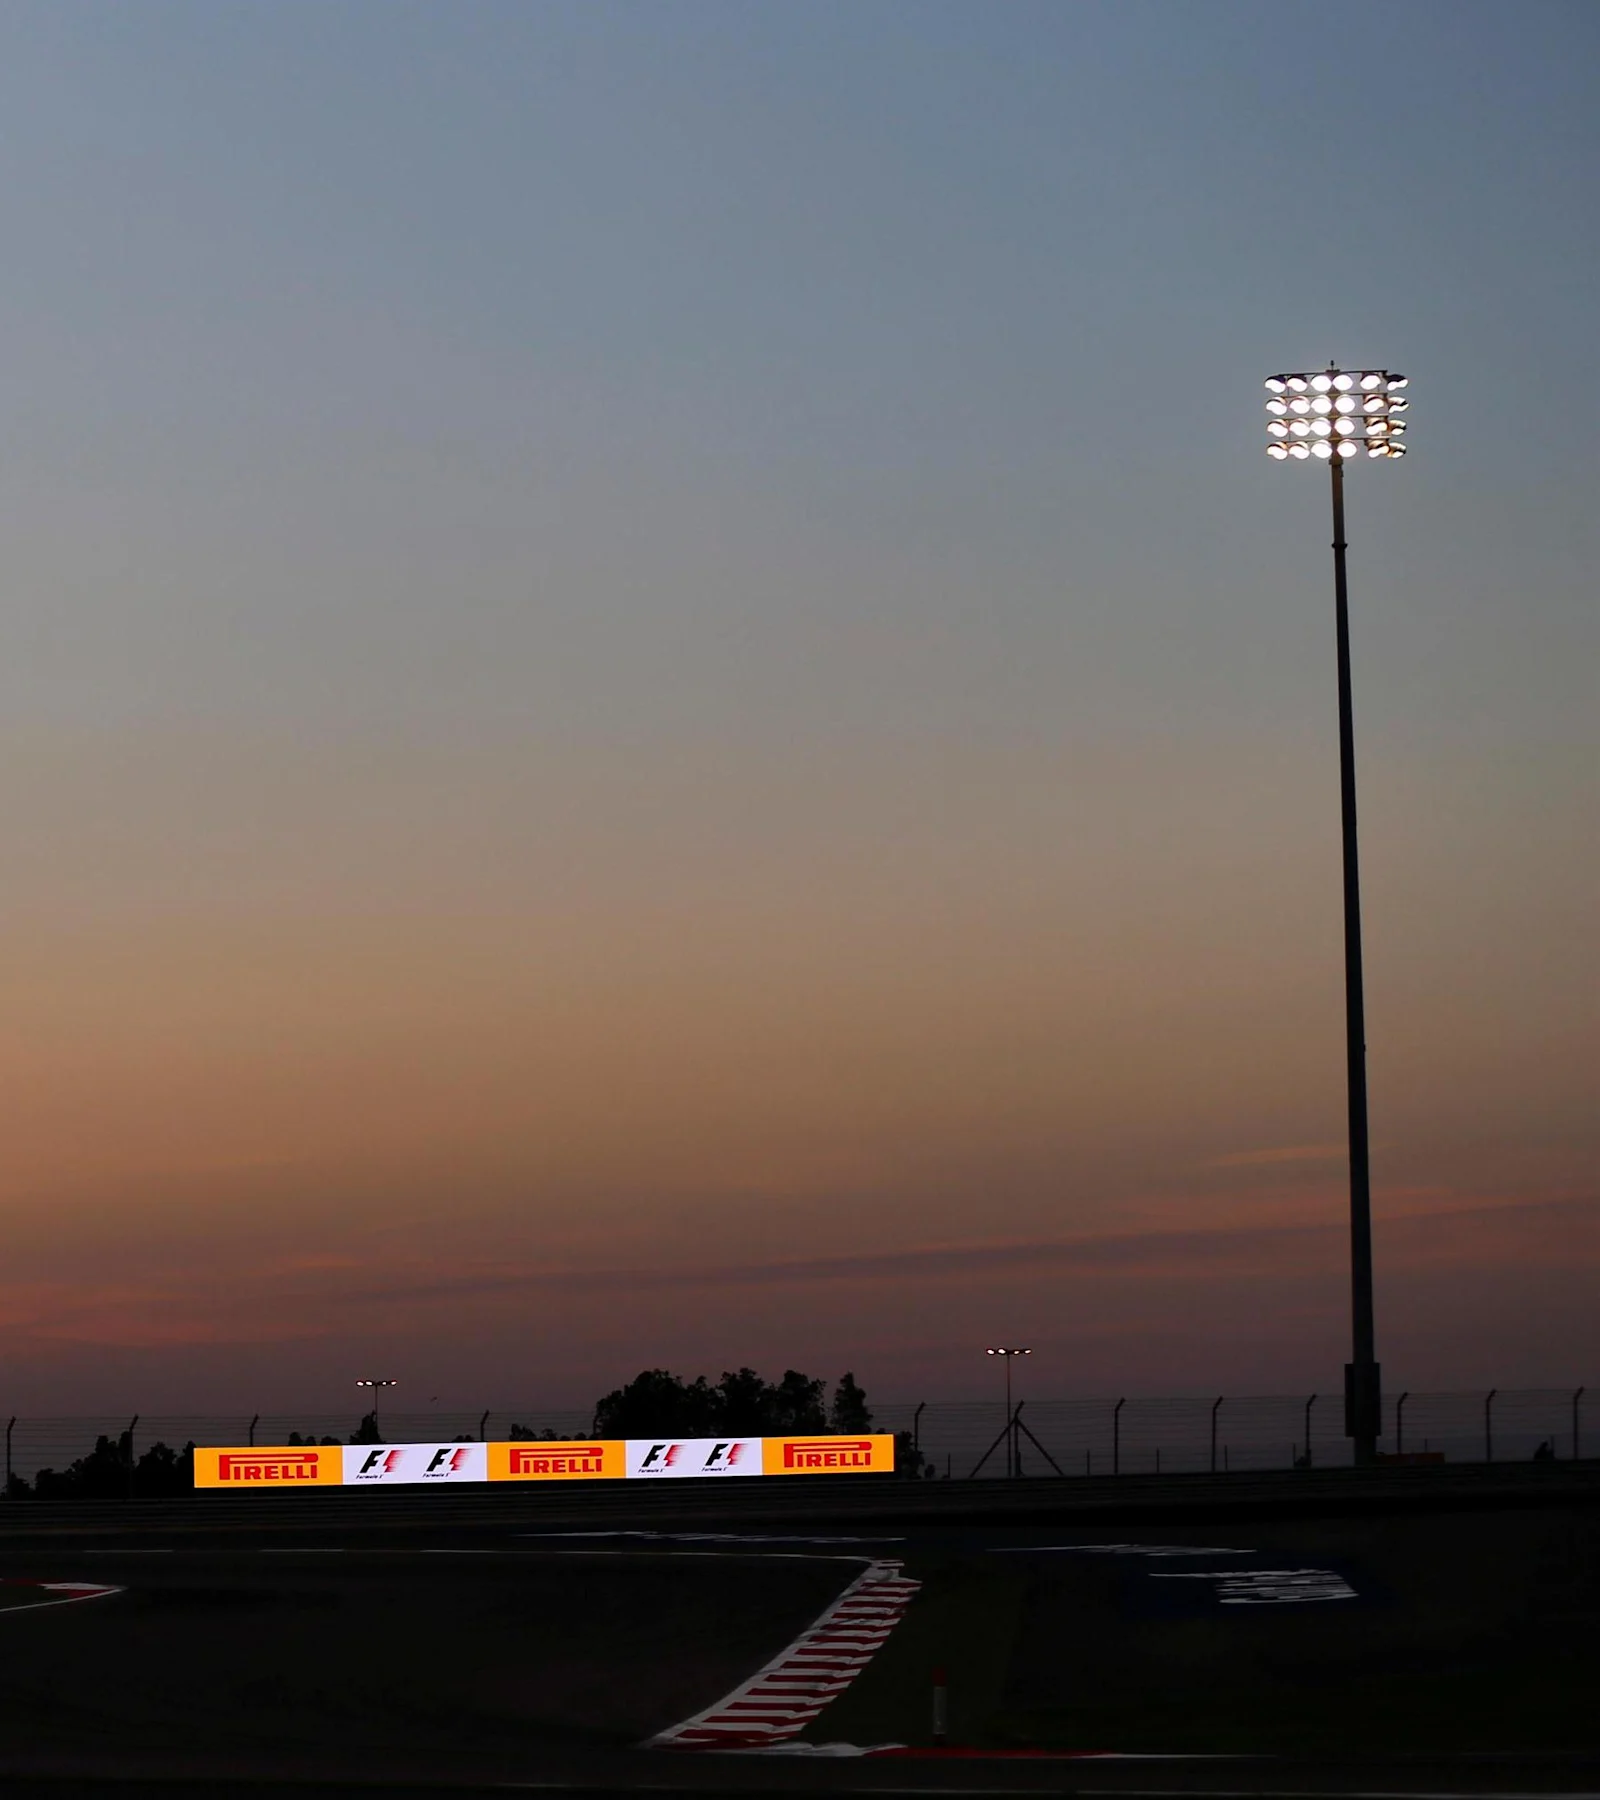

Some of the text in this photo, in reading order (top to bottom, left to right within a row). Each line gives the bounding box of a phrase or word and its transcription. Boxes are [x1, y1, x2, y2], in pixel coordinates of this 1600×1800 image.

[359, 1450, 407, 1473] F1
[426, 1448, 472, 1471] F1
[510, 1448, 604, 1475] PIRELLI
[642, 1445, 687, 1467] F1
[705, 1444, 749, 1466] F1
[784, 1442, 874, 1469] PIRELLI
[219, 1453, 319, 1481] PIRELLI
